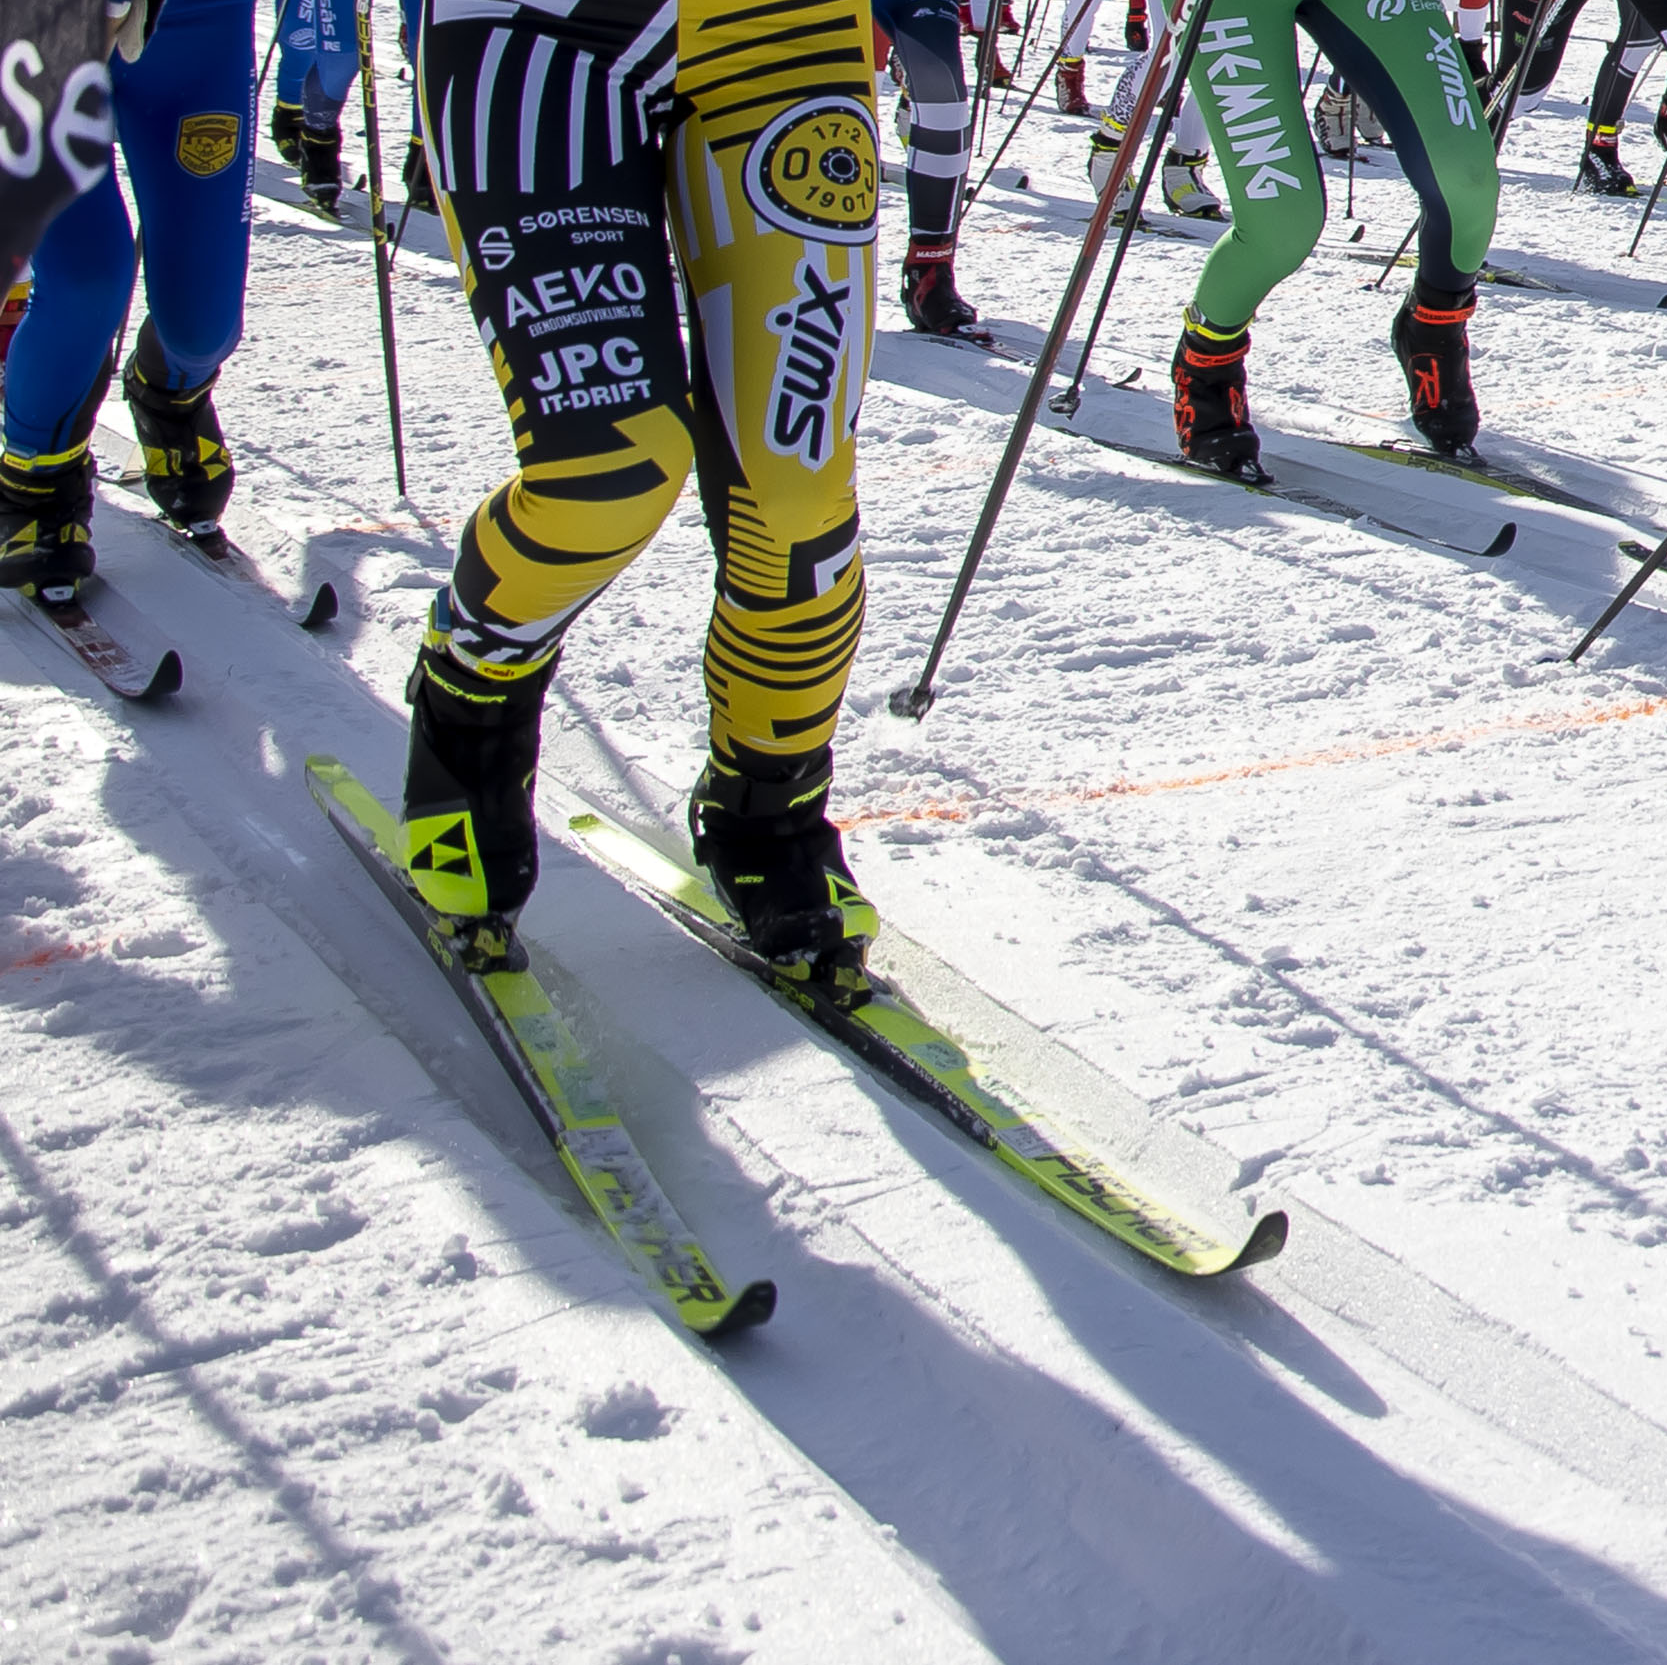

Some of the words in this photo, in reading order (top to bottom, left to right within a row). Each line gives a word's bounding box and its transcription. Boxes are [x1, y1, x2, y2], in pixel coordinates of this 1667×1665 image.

[1198, 17, 1302, 200] HEMING
[806, 185, 866, 213] 1907
[519, 206, 650, 234] SØRENSEN
[571, 230, 624, 244] SPORT
[507, 263, 647, 328] AEKO
[631, 305, 645, 318] AS
[531, 337, 644, 392] JPC
[539, 378, 651, 415] IT-DRIFT
